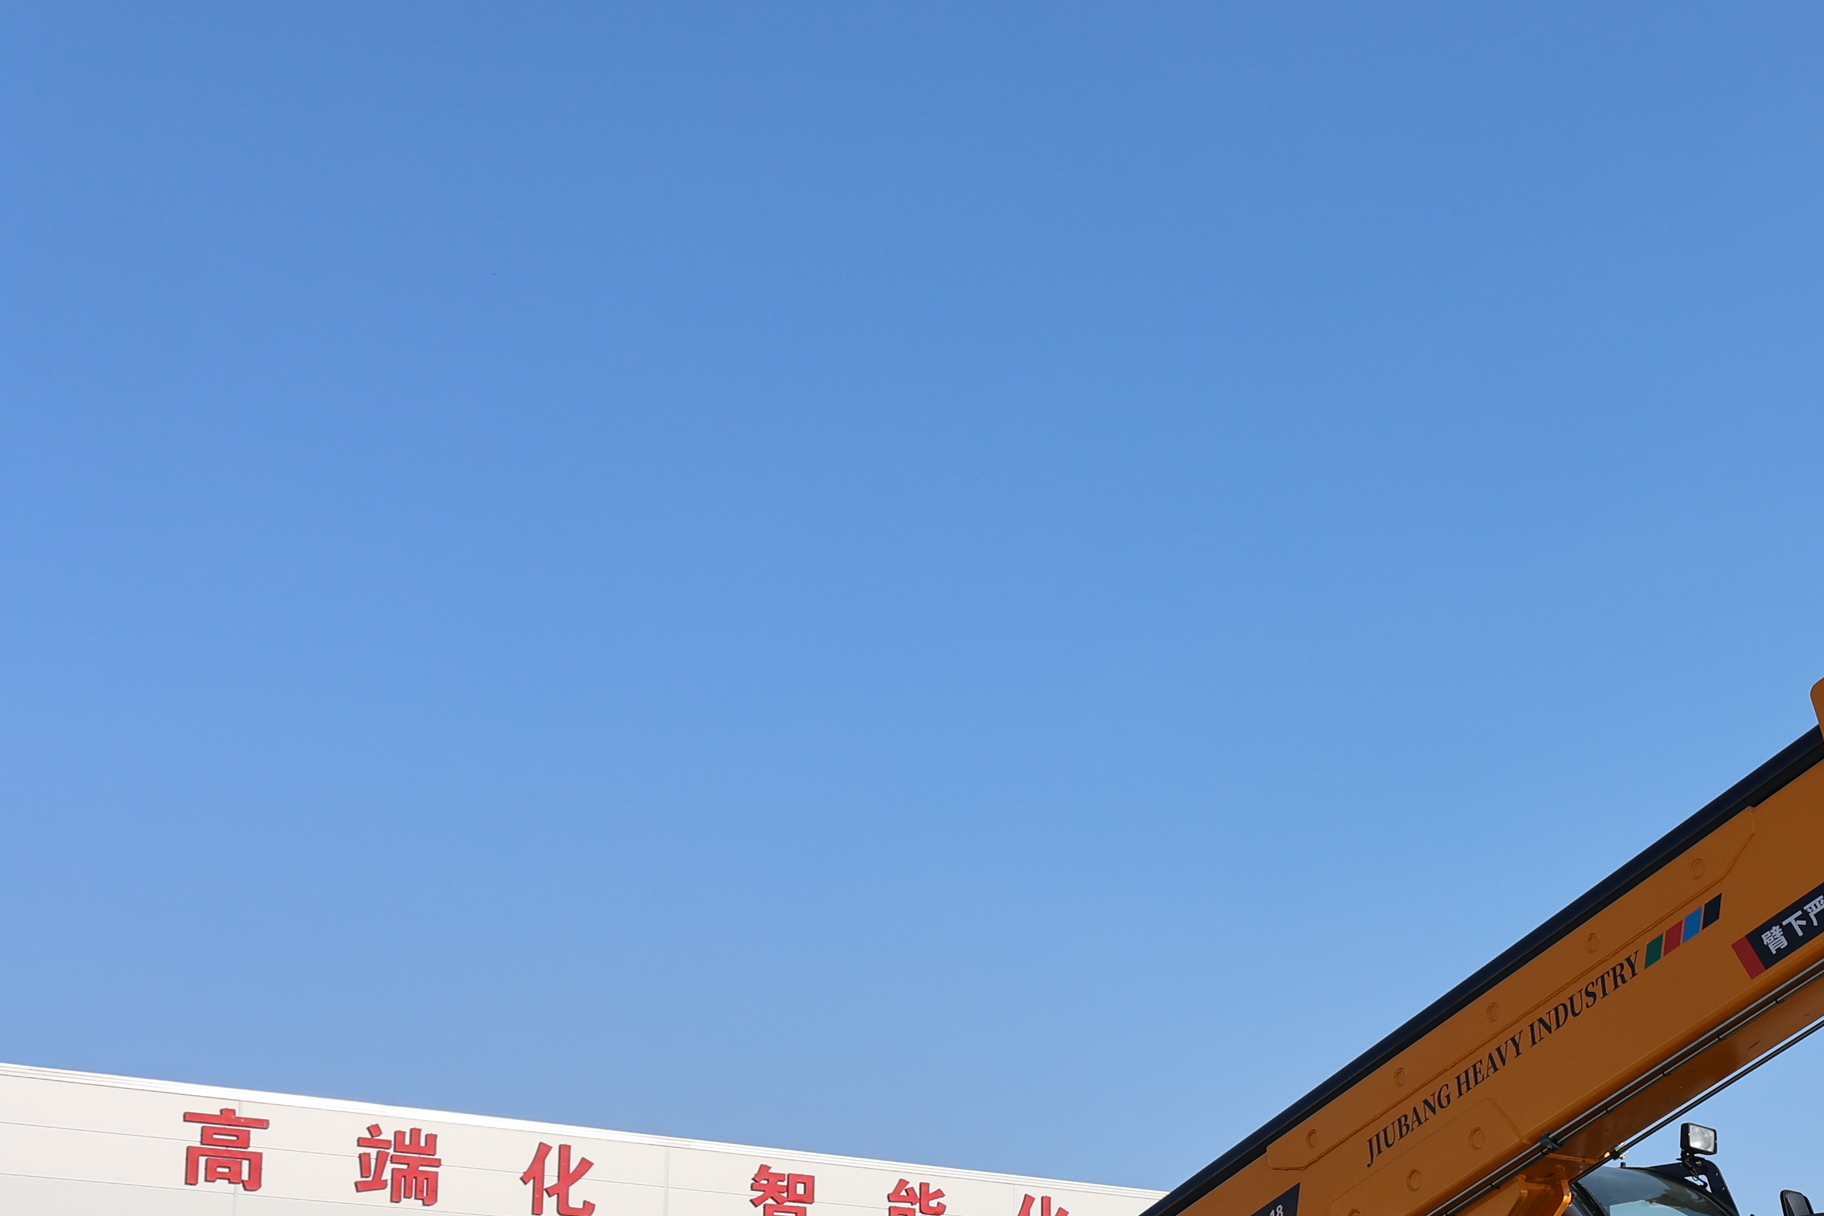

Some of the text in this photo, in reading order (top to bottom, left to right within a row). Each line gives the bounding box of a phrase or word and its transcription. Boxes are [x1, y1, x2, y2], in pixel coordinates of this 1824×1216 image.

[1366, 950, 1640, 1168] JIUBANG HEAVY INDUSTRY
